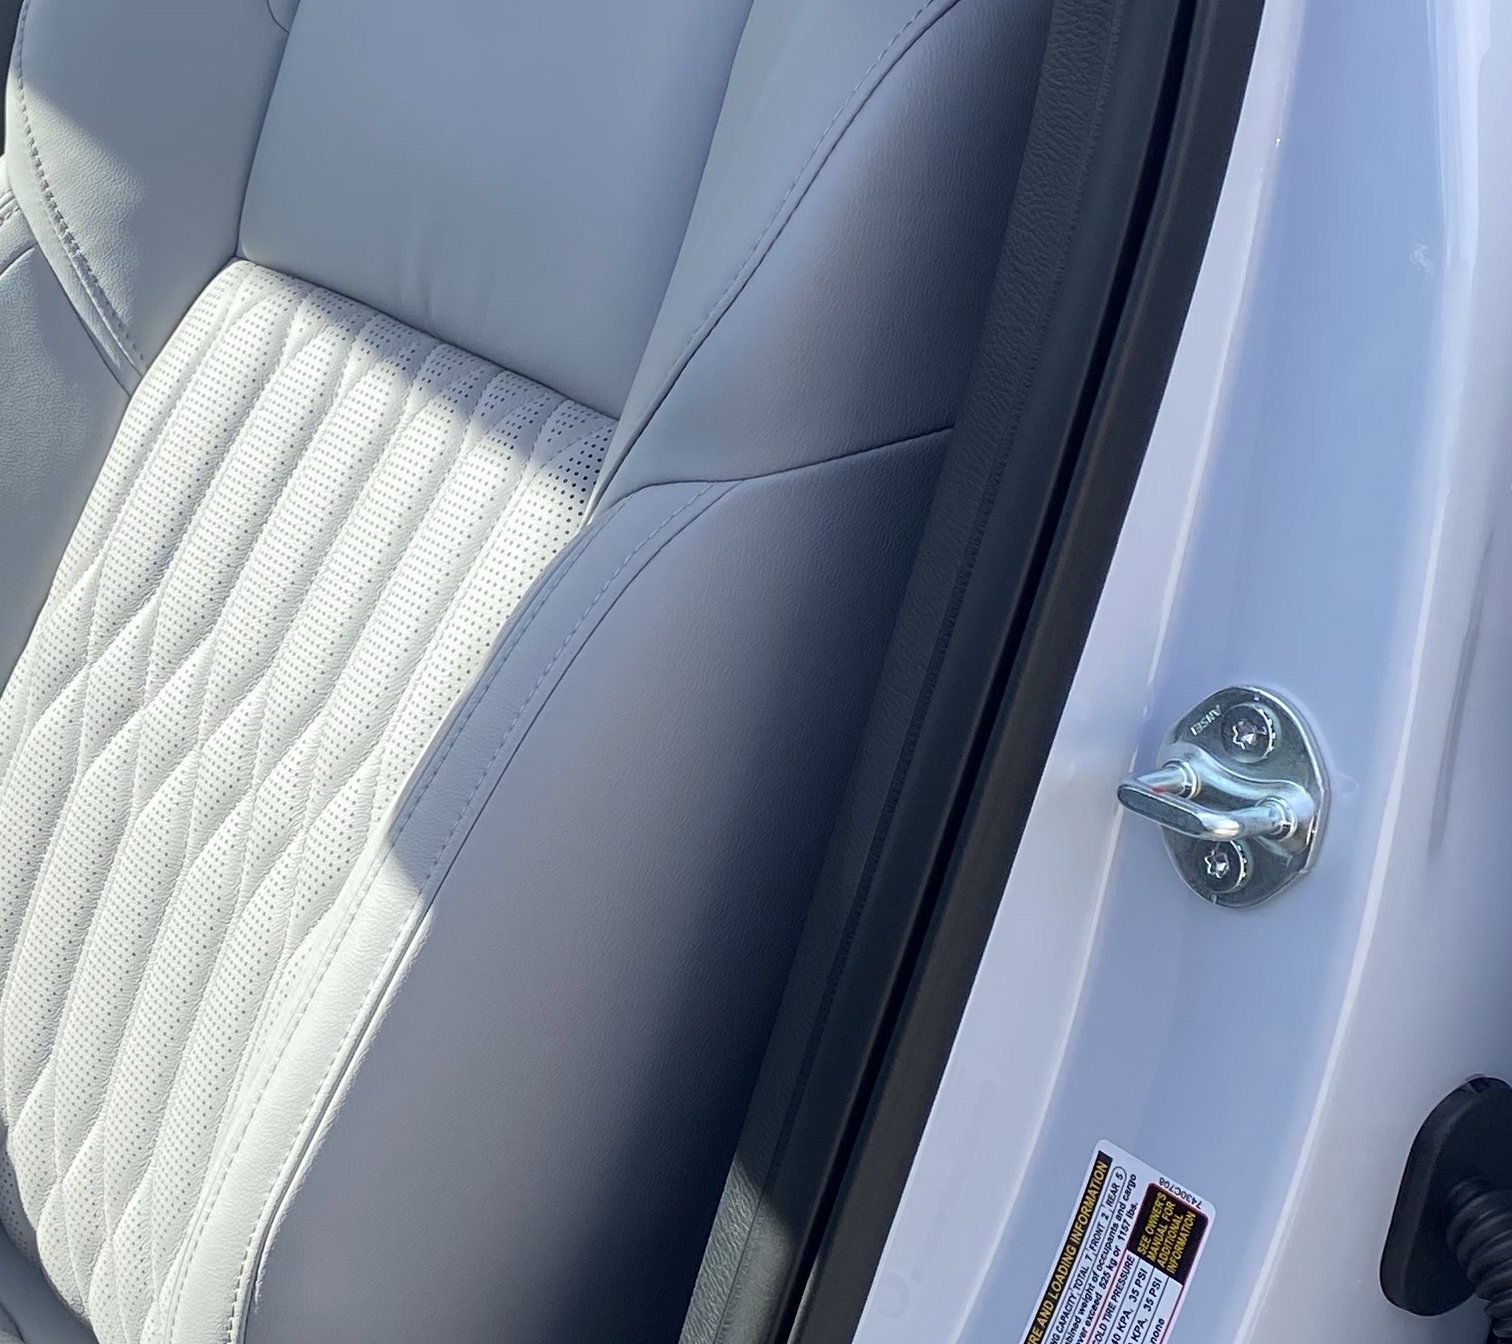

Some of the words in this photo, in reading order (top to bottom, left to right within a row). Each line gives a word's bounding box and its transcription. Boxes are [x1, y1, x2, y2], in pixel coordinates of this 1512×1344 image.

[1115, 1171, 1123, 1180] 5
[1121, 1172, 1139, 1202] cargo
[1104, 1182, 1120, 1207] REAR
[1125, 1199, 1138, 1219] lbs.
[1100, 1211, 1109, 1220] 2
[1113, 1200, 1126, 1221] and
[1143, 1190, 1168, 1235] OWNER'S
[1035, 1298, 1054, 1328] AND
[1047, 1242, 1077, 1300] LOADING
[1068, 1159, 1109, 1244] INFORMATION
[1088, 1221, 1106, 1251] FRONT
[1116, 1218, 1131, 1241] 1157
[1145, 1220, 1168, 1260] MANUAL
[1160, 1199, 1175, 1222] FOR
[1155, 1210, 1185, 1267] ADDITIONAL
[1165, 1210, 1197, 1273] INFORMATION
[1084, 1253, 1093, 1262] 7
[1094, 1220, 1121, 1272] occupants
[1111, 1244, 1121, 1257] or
[1137, 1234, 1151, 1255] SEE
[1072, 1263, 1089, 1291] TOTAL
[1089, 1270, 1100, 1283] of
[1105, 1256, 1118, 1272] kg
[1098, 1269, 1111, 1289] 525
[1102, 1301, 1116, 1323] TIRE
[1110, 1253, 1135, 1303] PRESSURE
[1055, 1292, 1077, 1334] CAPACITY
[1076, 1281, 1097, 1317] weight
[1082, 1291, 1102, 1327] exceed
[1116, 1305, 1134, 1334] KPA,
[1128, 1287, 1139, 1303] 35
[1134, 1267, 1148, 1288] PSI
[1130, 1314, 1148, 1343] KPA,
[1142, 1297, 1154, 1312] 35
[1148, 1276, 1162, 1297] PSI
[1148, 1316, 1165, 1344] none
